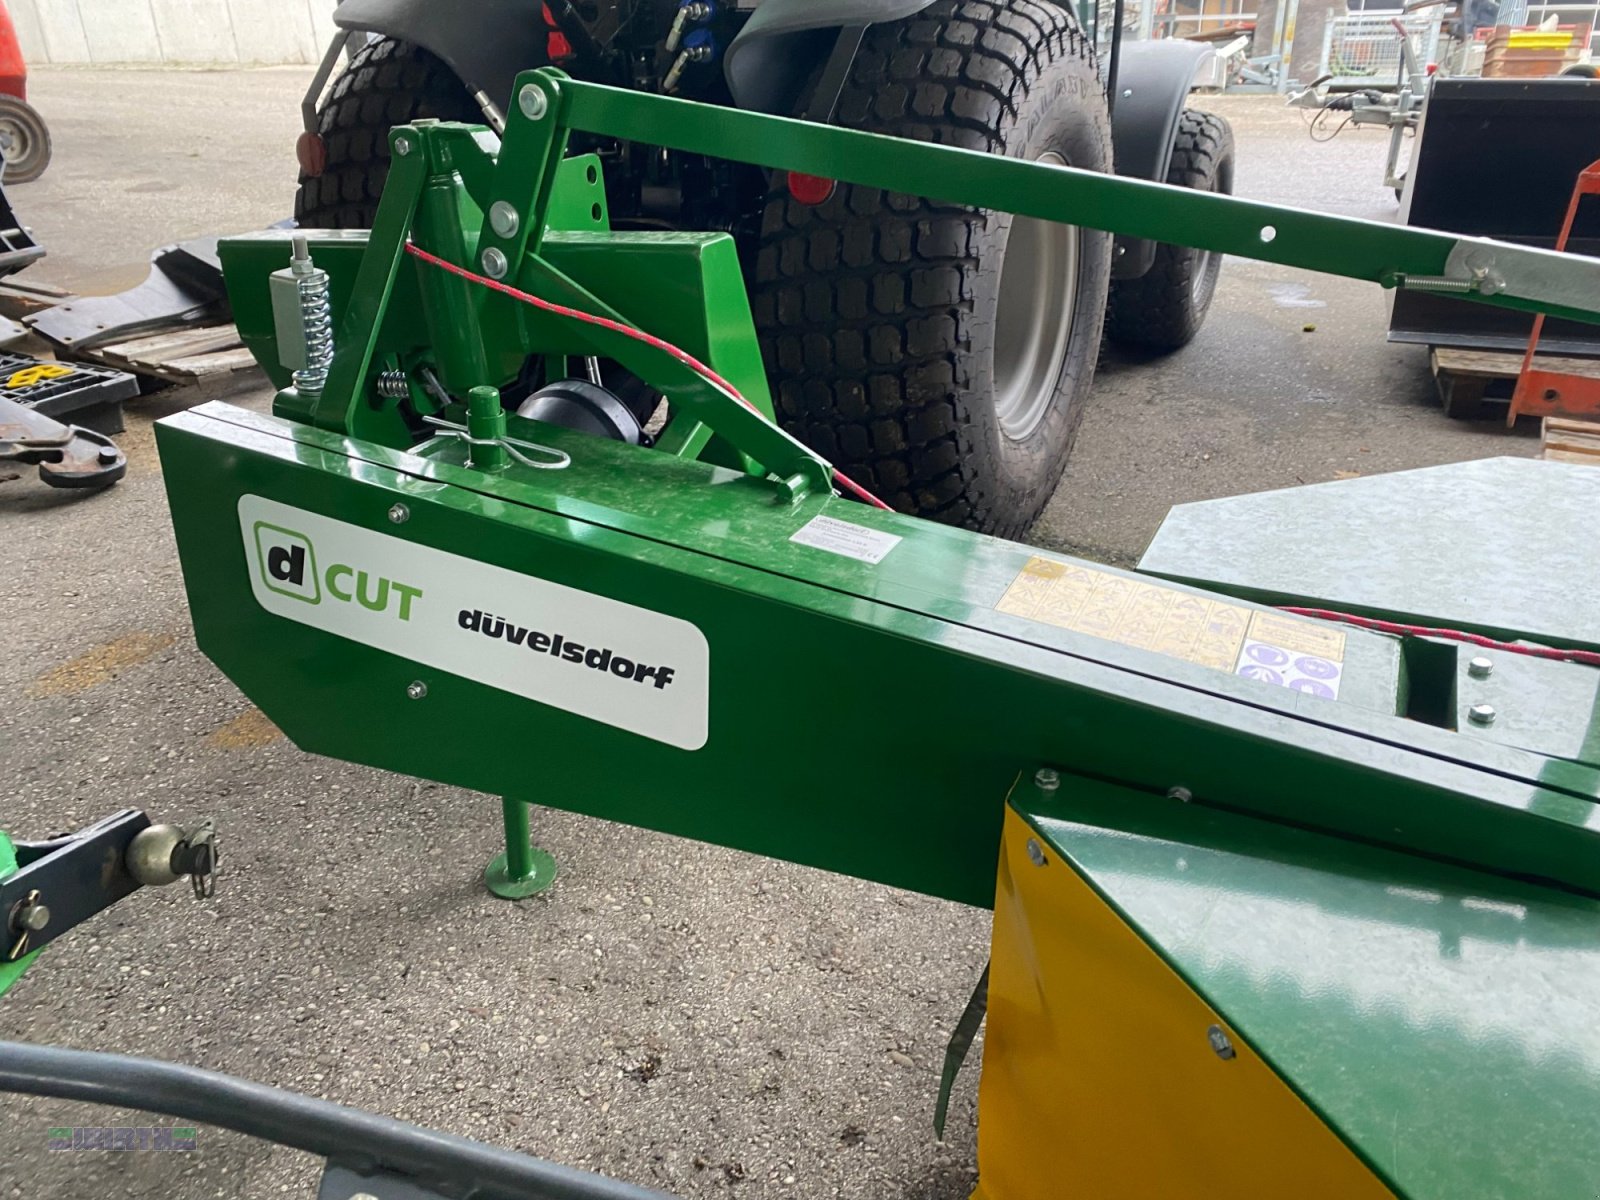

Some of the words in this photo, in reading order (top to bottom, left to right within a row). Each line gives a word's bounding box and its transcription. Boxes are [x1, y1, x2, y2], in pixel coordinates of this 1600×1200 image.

[268, 544, 305, 586] d
[325, 563, 423, 622] CUT
[458, 609, 675, 690] düvelsdorf
